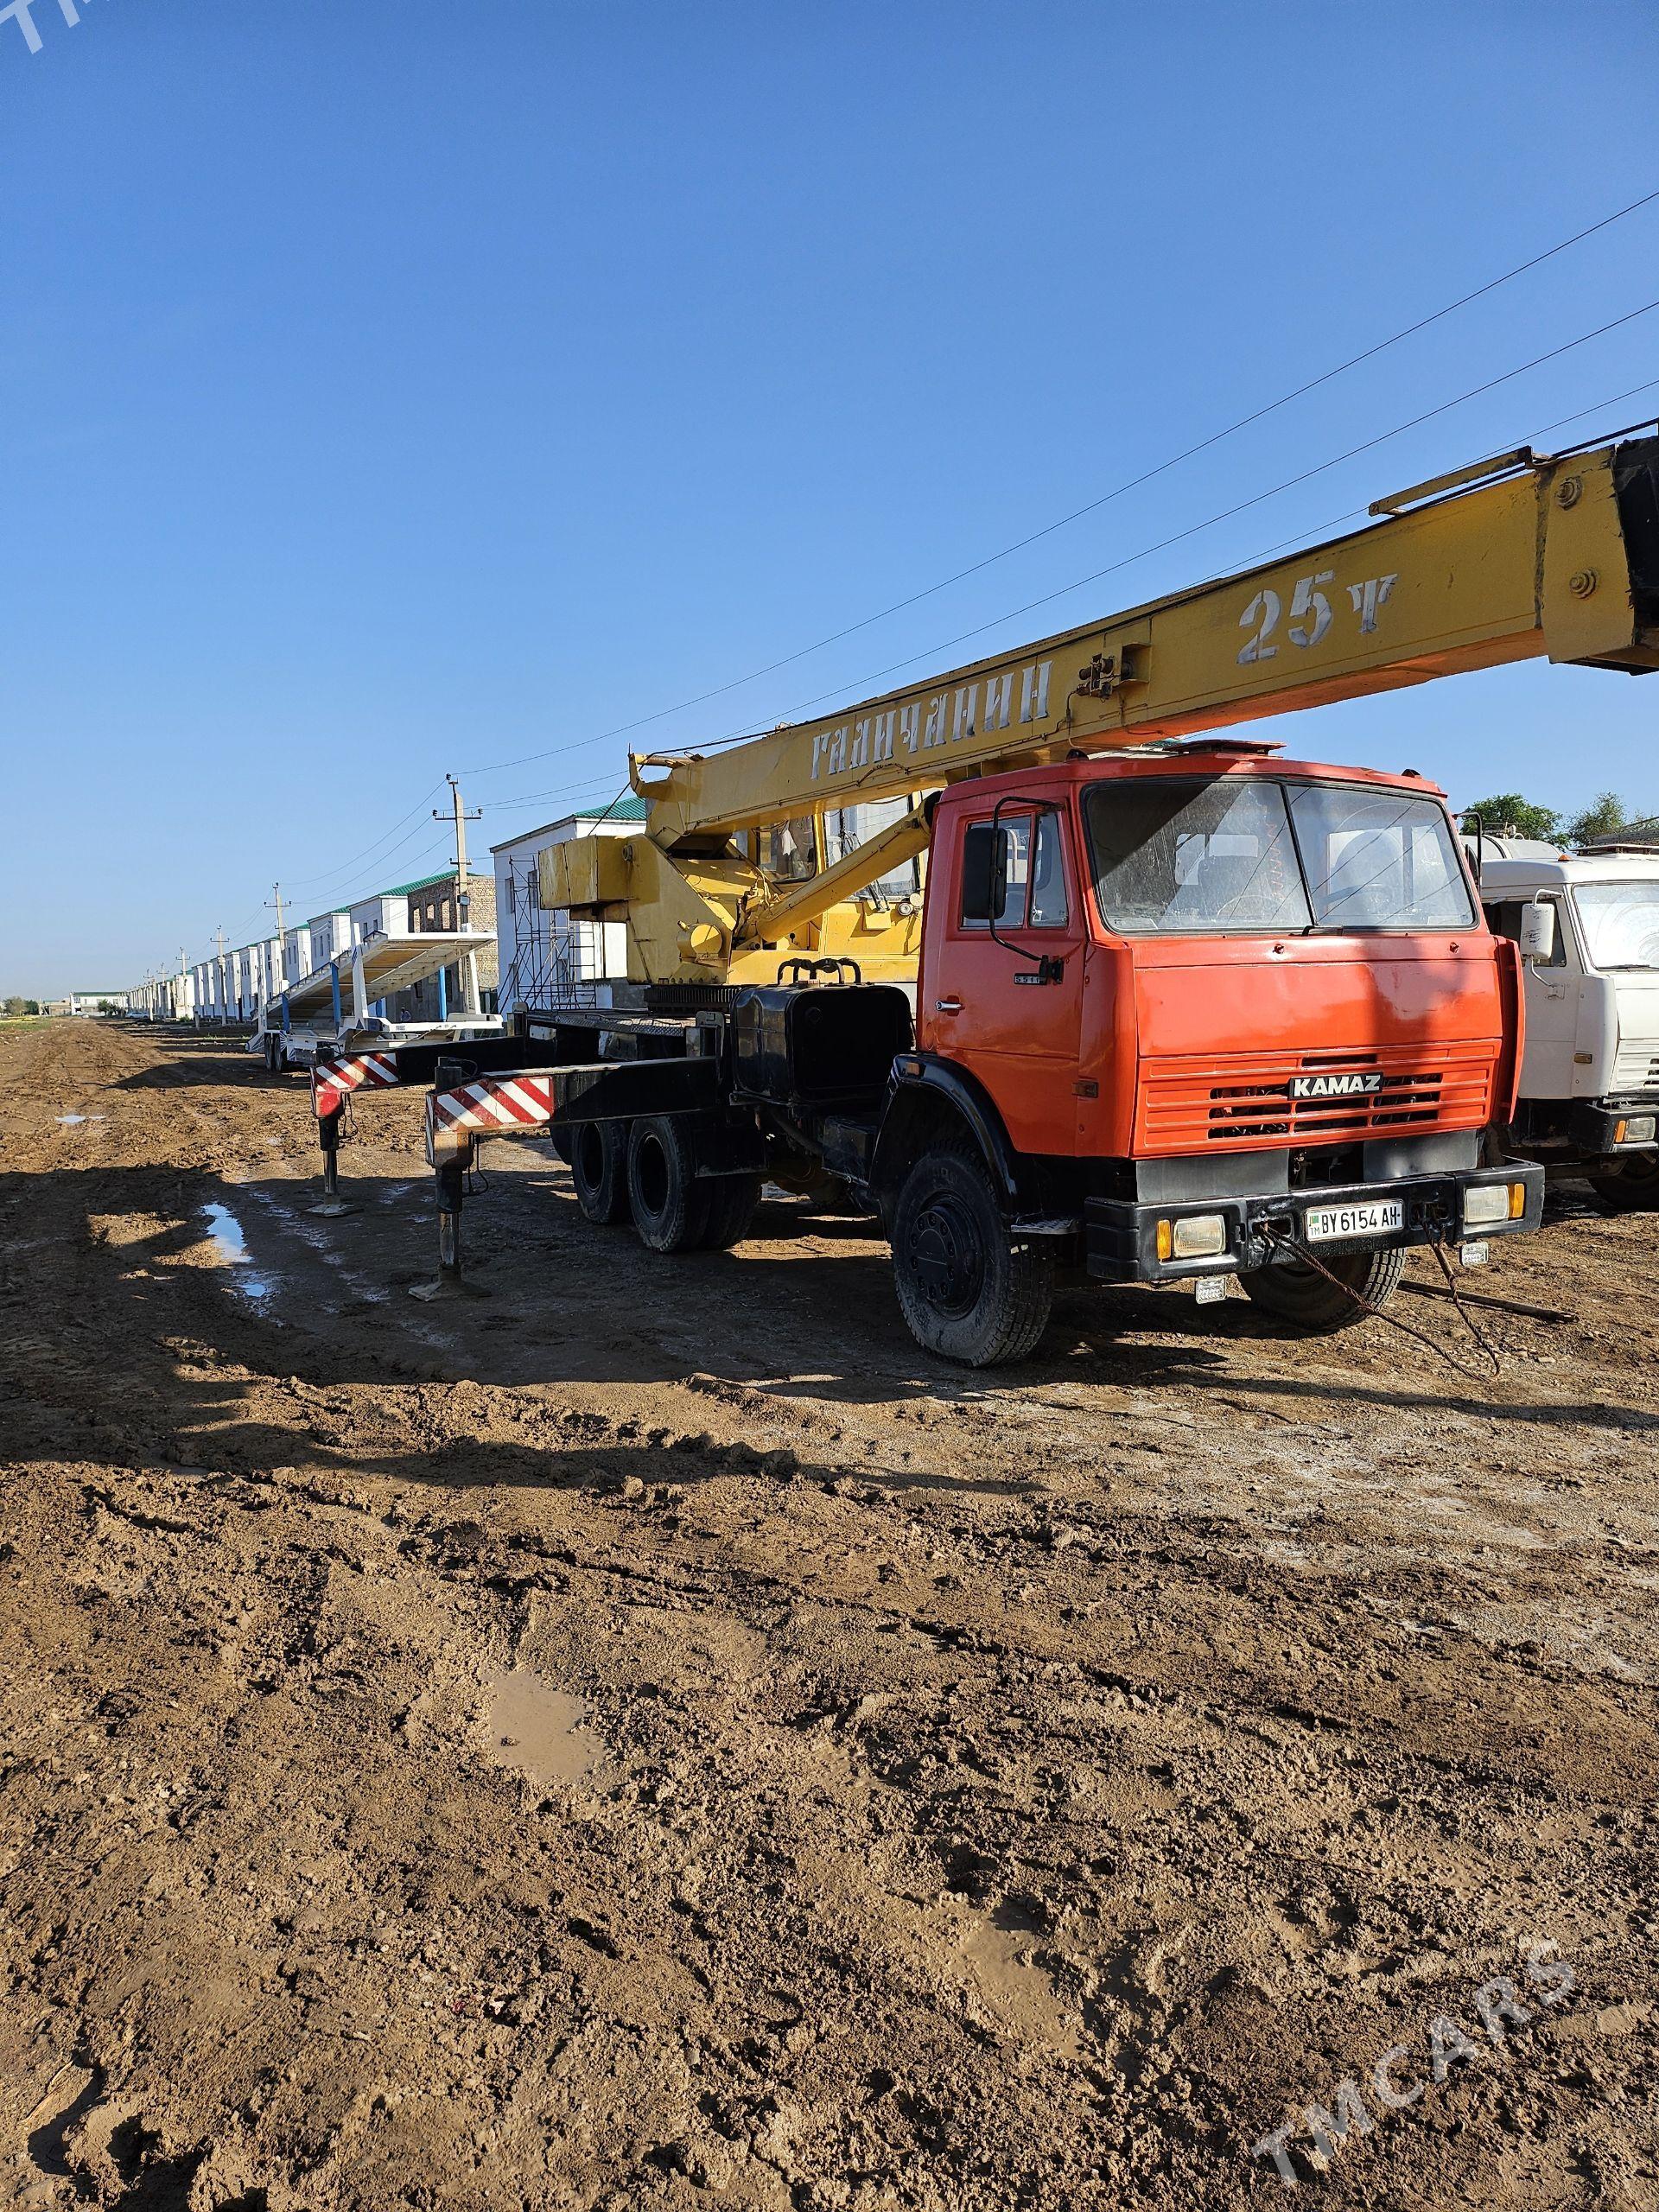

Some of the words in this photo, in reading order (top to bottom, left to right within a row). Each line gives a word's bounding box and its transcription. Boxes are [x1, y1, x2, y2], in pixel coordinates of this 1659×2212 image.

[1236, 569, 1336, 665] 25
[1294, 1075, 1381, 1097] KAMAZ
[1310, 1227, 1320, 1236] TM
[1321, 1213, 1338, 1234] BY
[1340, 1210, 1377, 1231] 6154
[1382, 1206, 1398, 1227] AH
